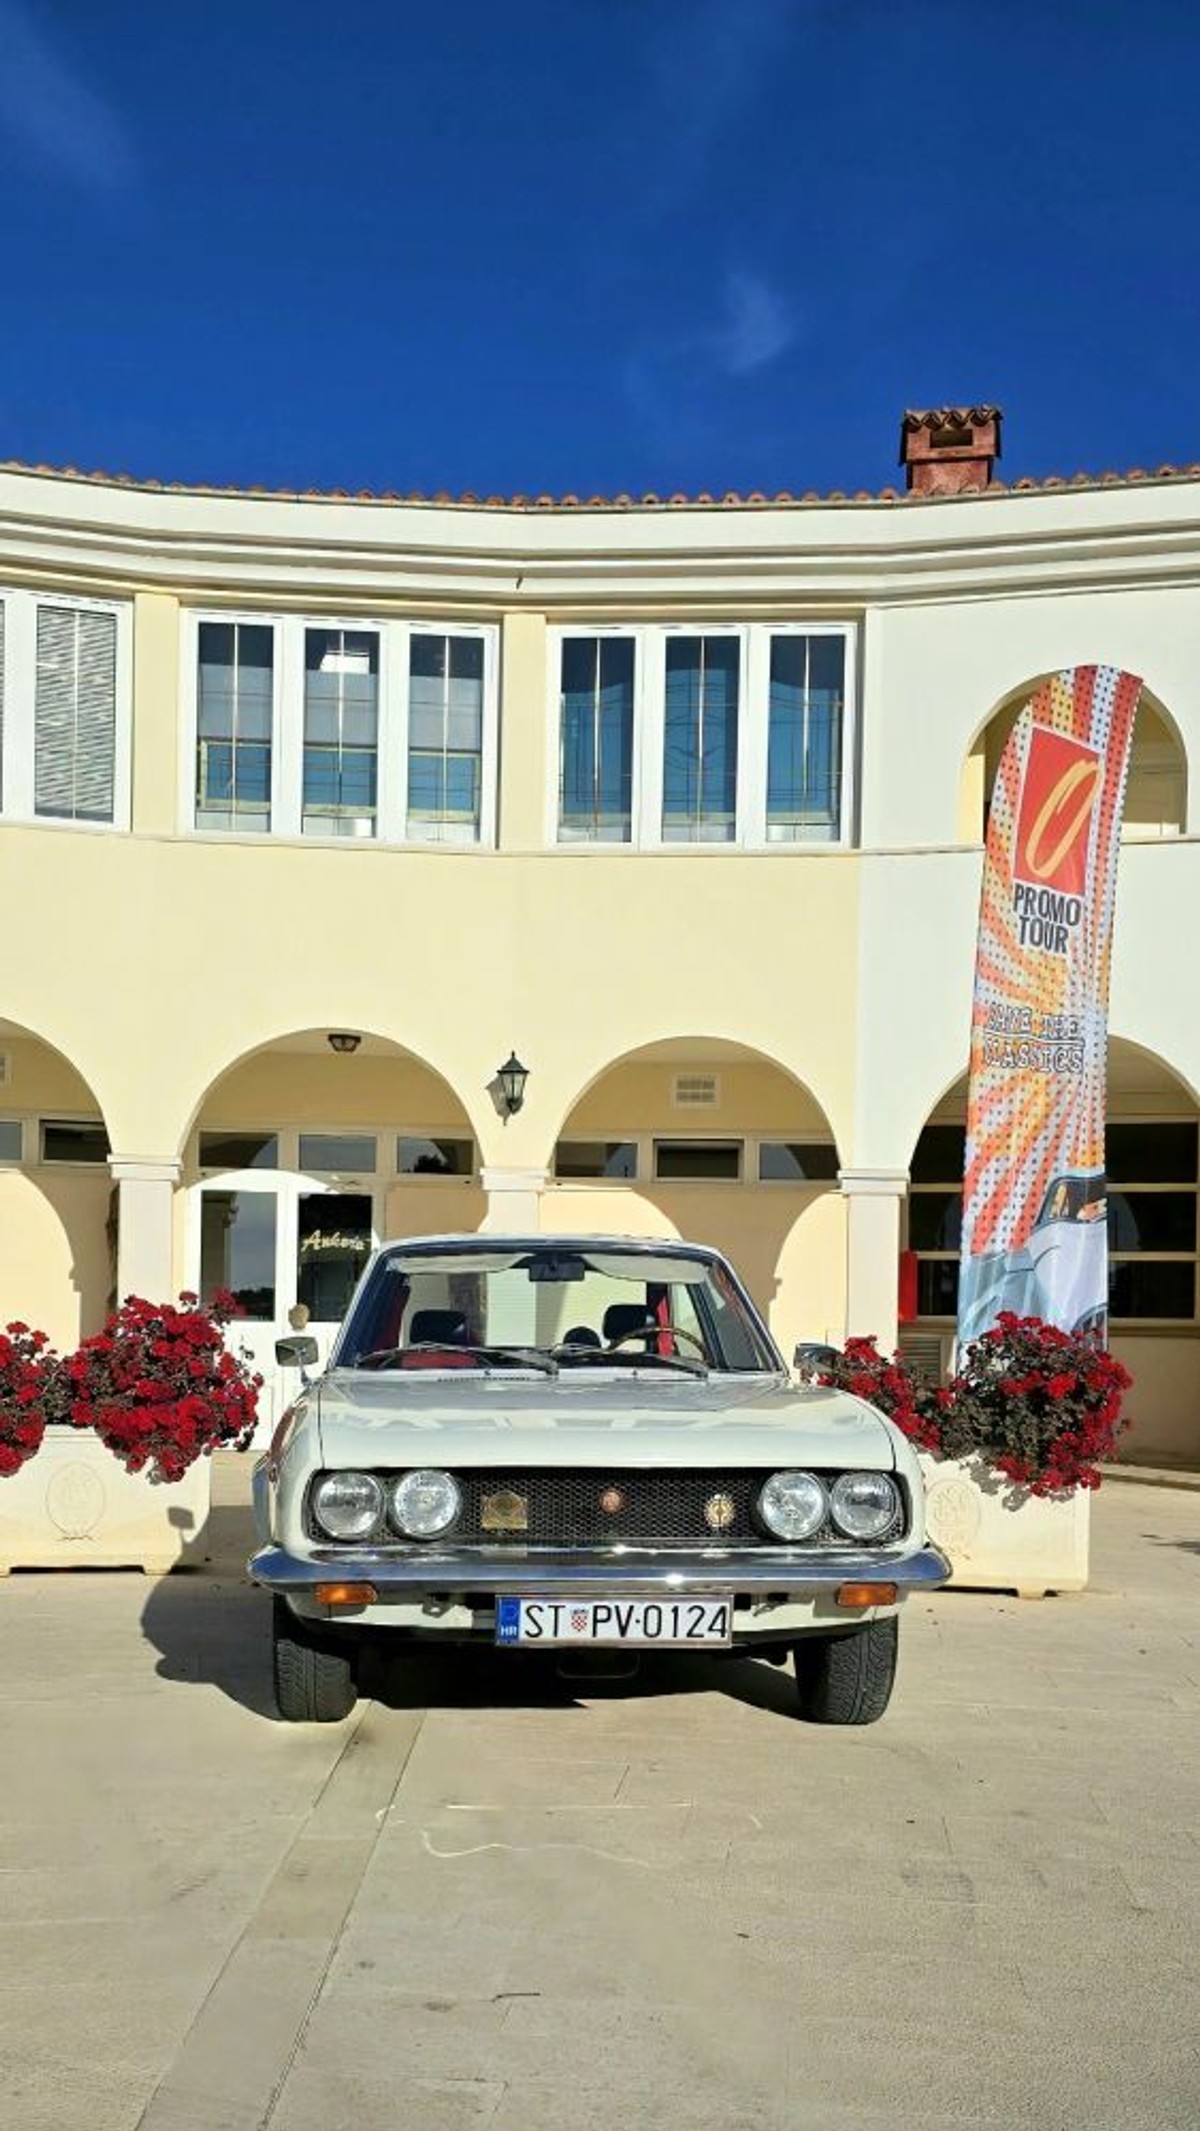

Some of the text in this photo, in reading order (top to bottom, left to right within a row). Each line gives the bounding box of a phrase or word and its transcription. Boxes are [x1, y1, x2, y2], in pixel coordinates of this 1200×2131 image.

[1013, 884, 1081, 927] PROMO
[1018, 916, 1069, 954] TOUR
[1040, 1013, 1081, 1040] THE
[984, 1038, 1085, 1075] CLASSICS
[500, 1626, 517, 1636] HR
[525, 1605, 566, 1638] ST
